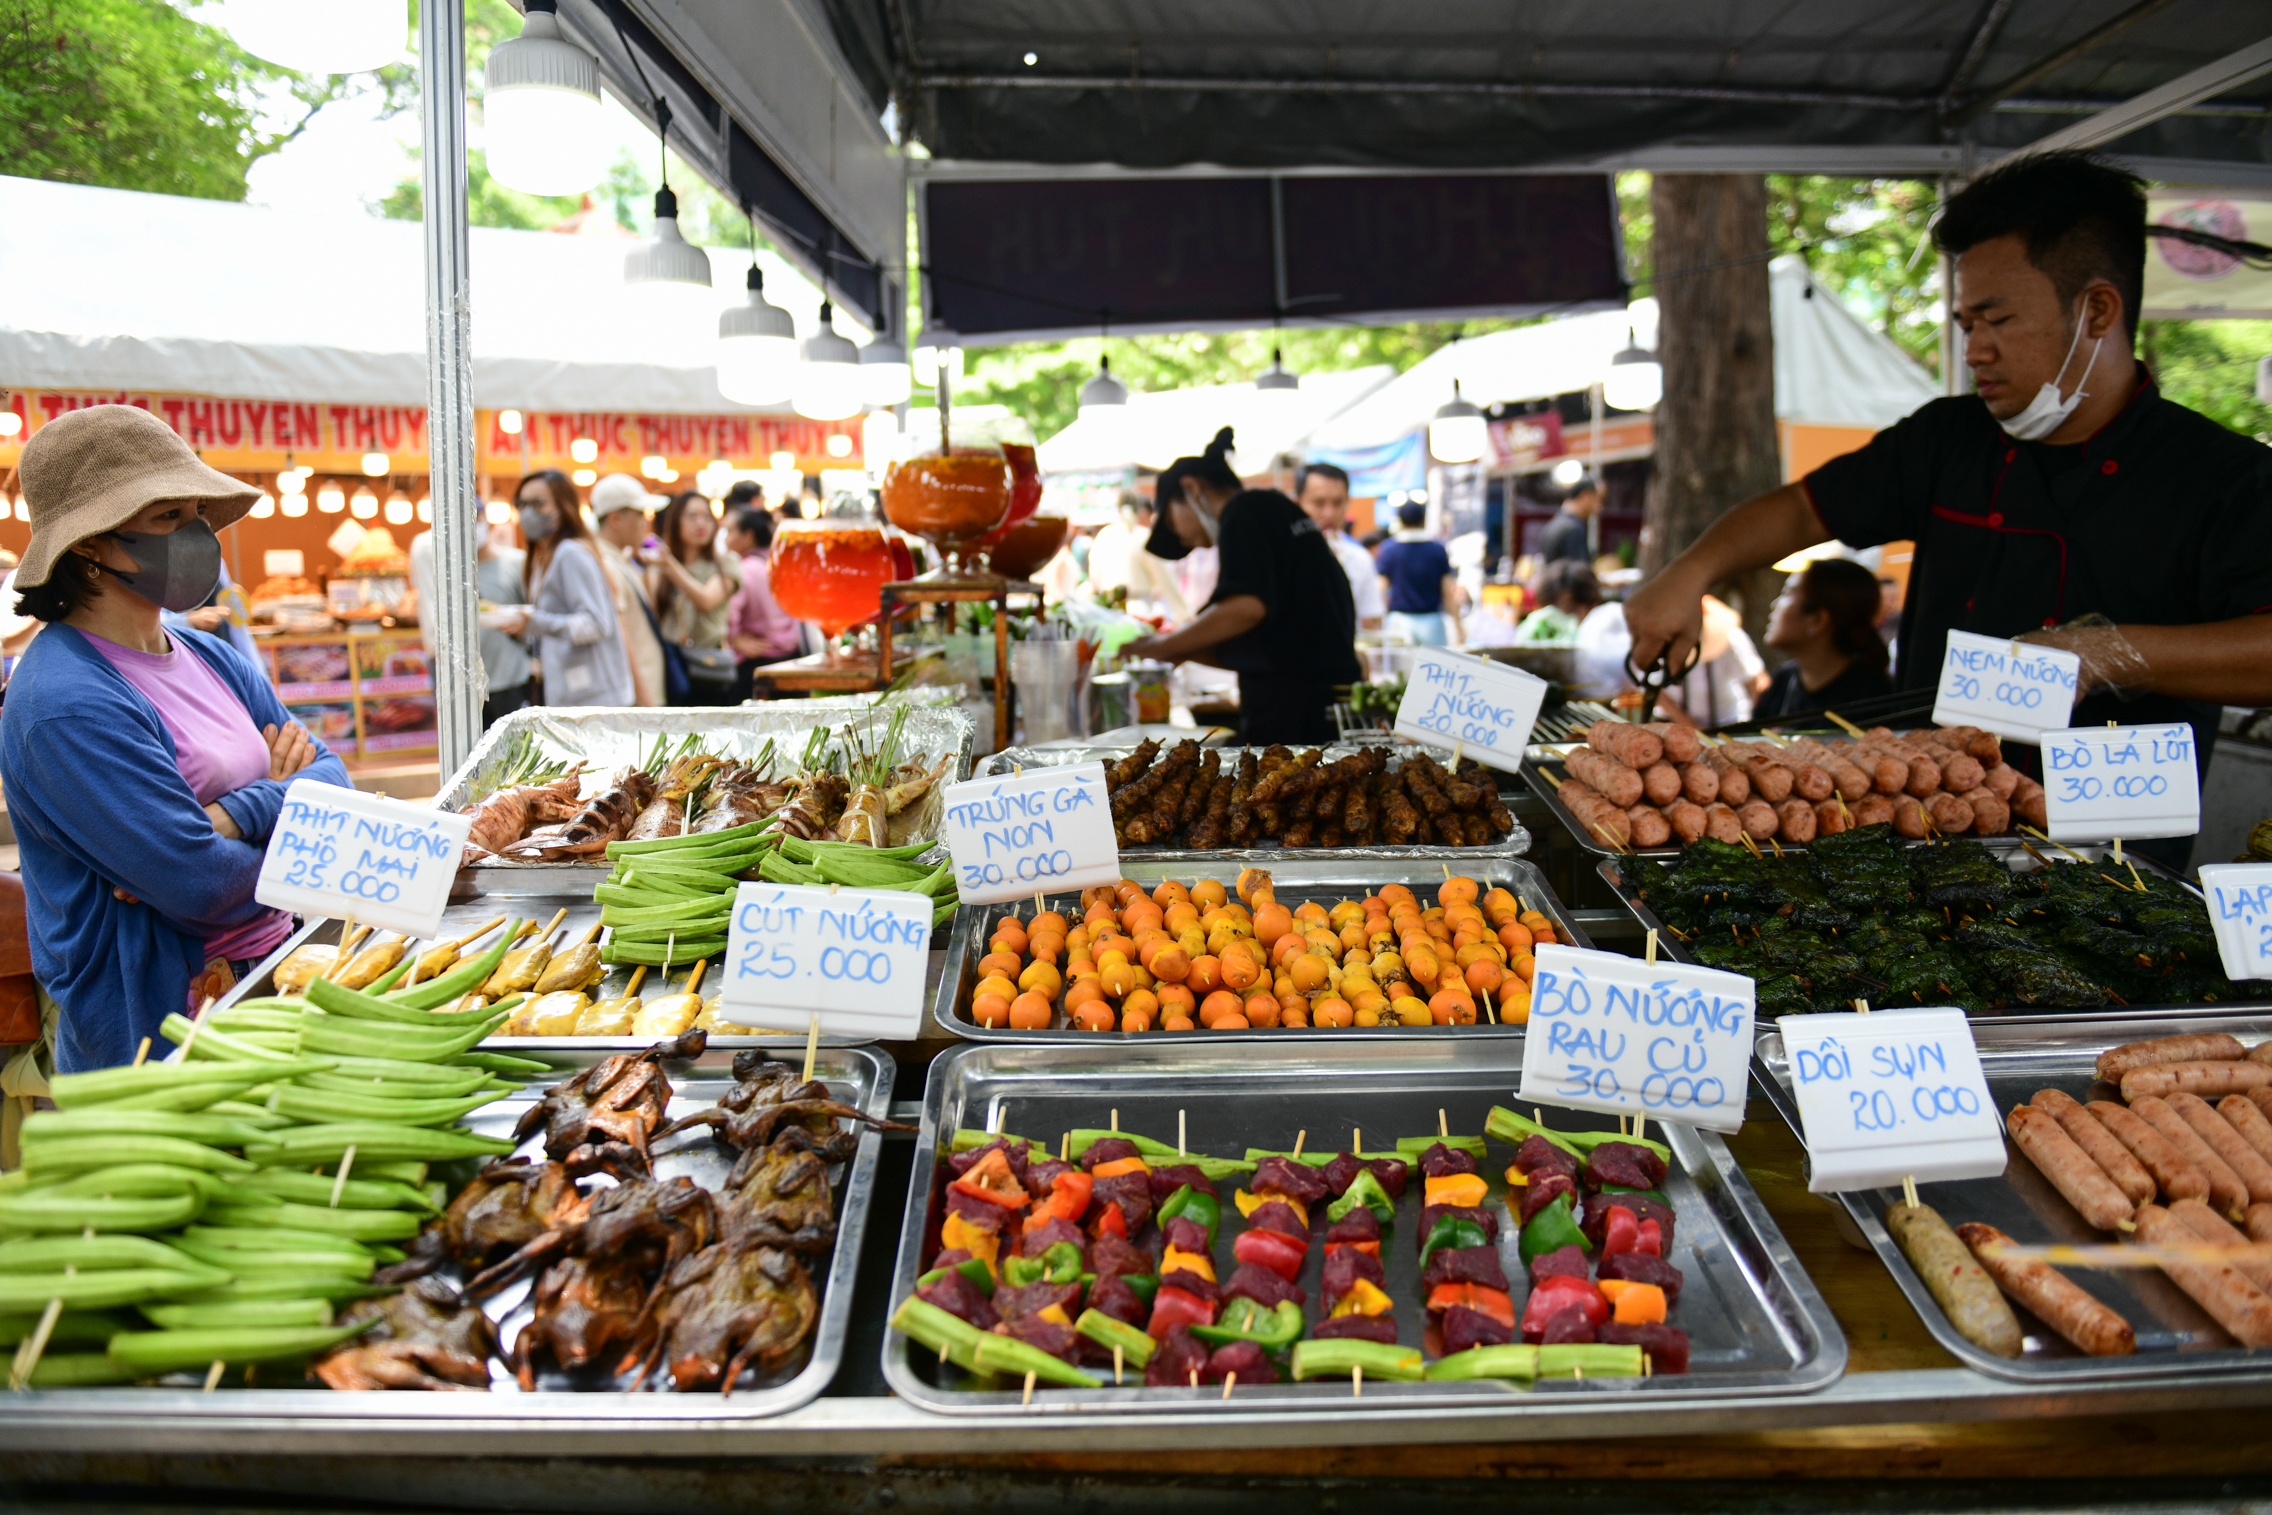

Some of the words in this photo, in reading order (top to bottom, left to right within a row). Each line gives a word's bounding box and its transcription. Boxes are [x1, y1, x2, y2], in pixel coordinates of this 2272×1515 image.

[1949, 647, 2005, 674] NEM
[1417, 708, 1498, 747] 20.000
[2047, 738, 2092, 771] BÒ
[2102, 729, 2141, 765] LÁ
[947, 784, 1045, 829] TRỨNG
[1053, 775, 1095, 813] GÀ
[2056, 774, 2168, 803] 30.000
[982, 818, 1055, 859] NON
[283, 859, 401, 904] 25.000
[961, 849, 1073, 890] 30.000
[738, 890, 804, 934] CÚT
[737, 940, 893, 985] 25.000
[1530, 966, 1592, 1018] BÒ
[1547, 1020, 1627, 1063] RAU
[1646, 1027, 1708, 1075] CỦ
[1555, 1063, 1726, 1109] 30.000
[1849, 1084, 1981, 1132] 20.000
